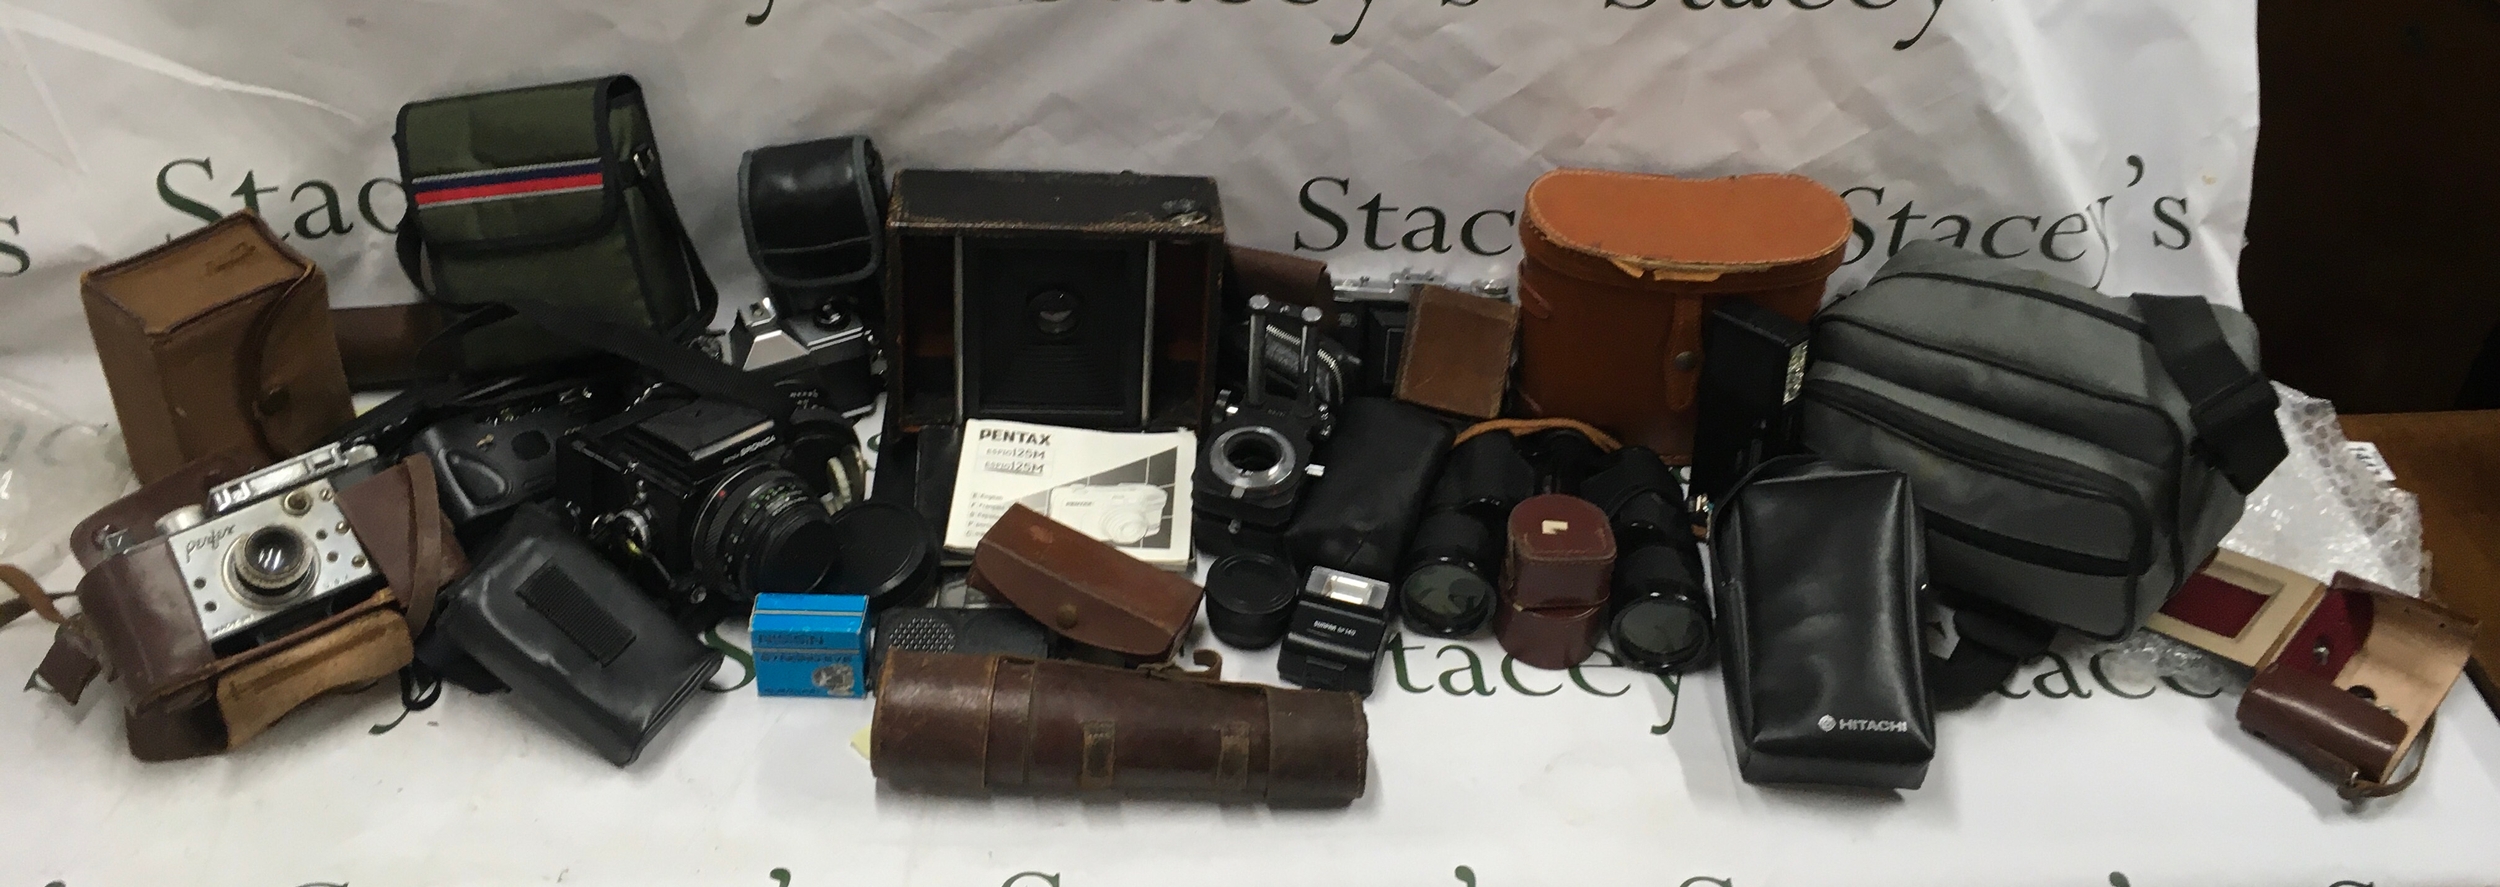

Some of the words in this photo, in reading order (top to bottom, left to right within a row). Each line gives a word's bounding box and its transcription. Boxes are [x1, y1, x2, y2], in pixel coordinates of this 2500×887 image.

[156, 157, 407, 239] Stac
[1294, 176, 1516, 257] Stac
[978, 428, 1052, 446] PENTAX
[1838, 718, 1909, 733] HITACHI
